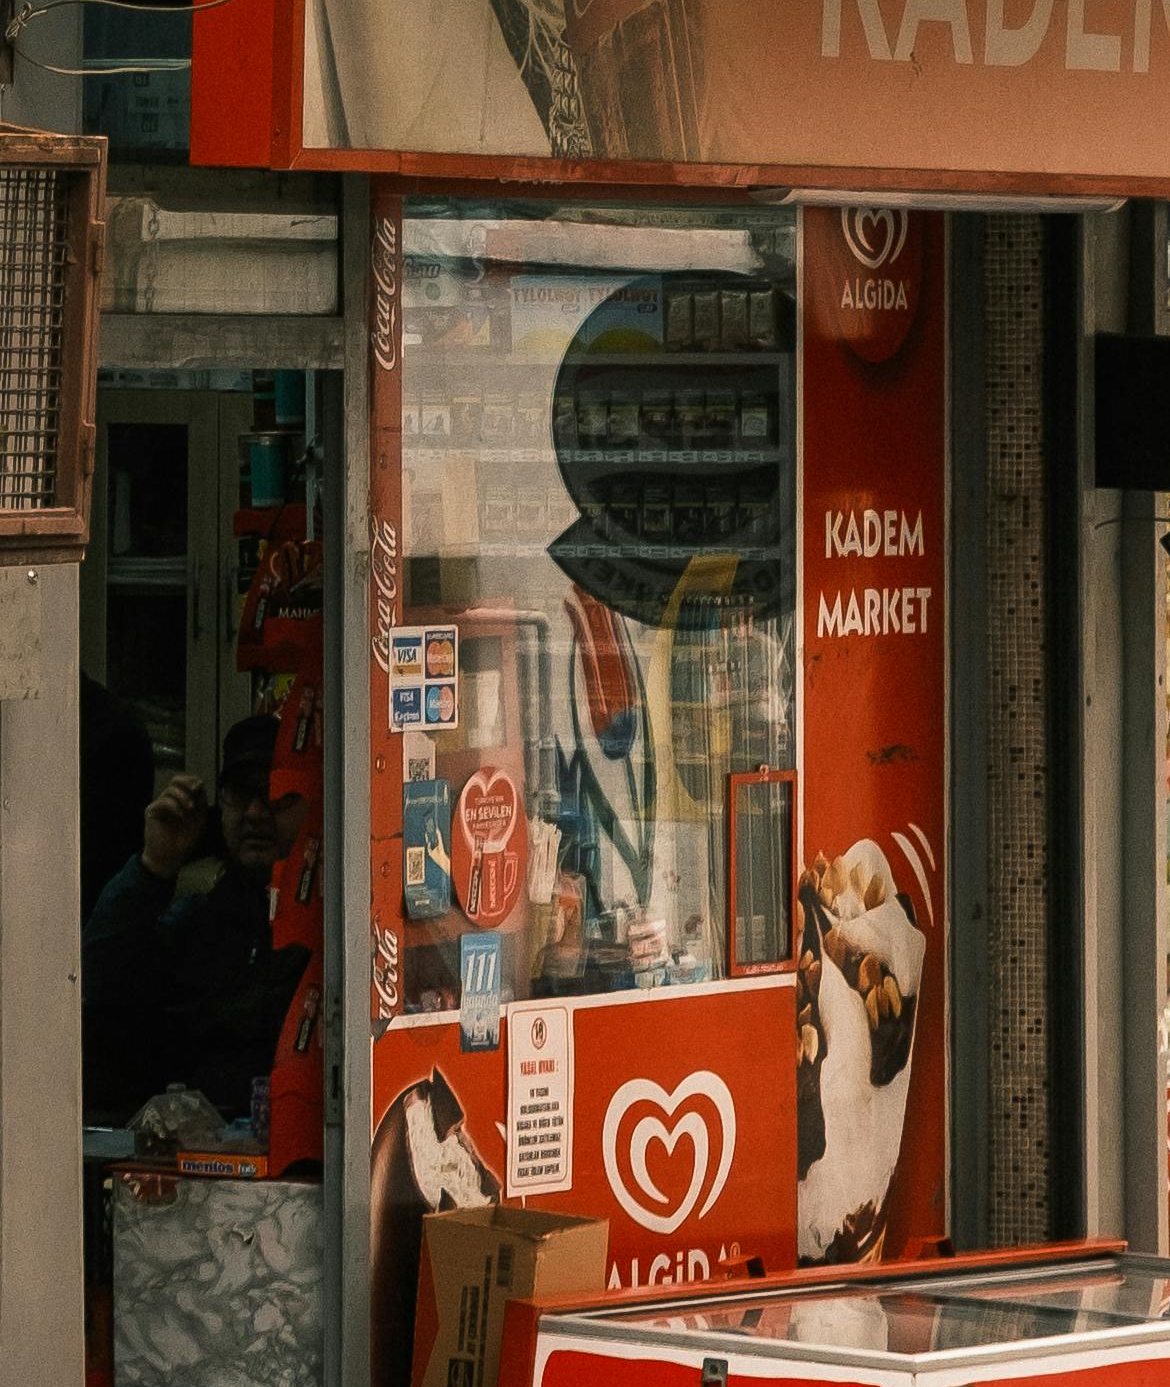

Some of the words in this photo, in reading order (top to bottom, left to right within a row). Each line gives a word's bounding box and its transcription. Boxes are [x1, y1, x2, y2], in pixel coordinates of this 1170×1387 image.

[824, 510, 926, 559] KADEM
[817, 586, 932, 640] MARKET
[465, 948, 499, 992] 111
